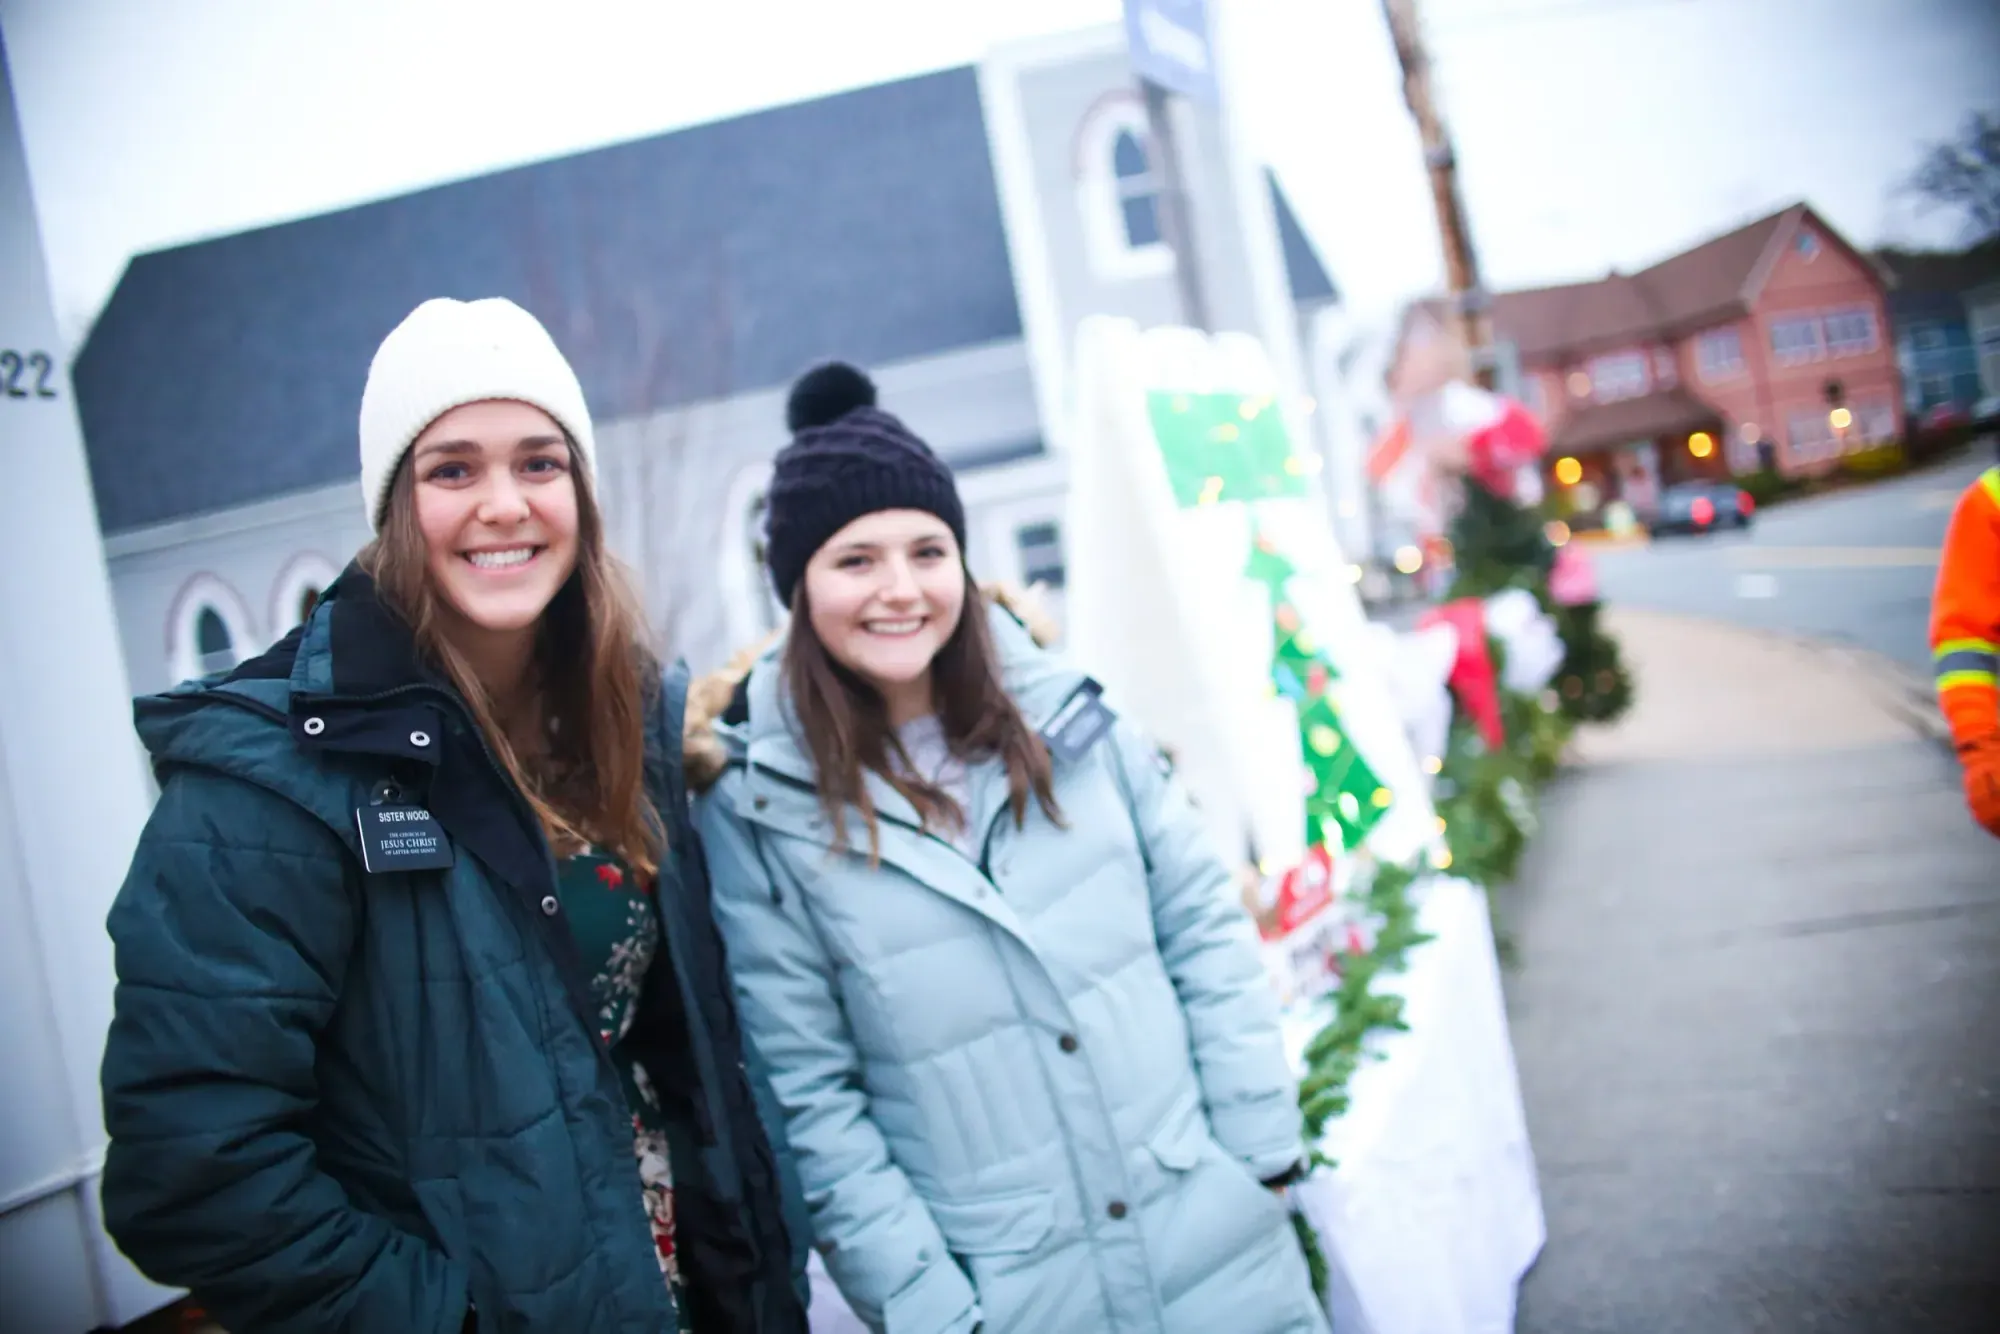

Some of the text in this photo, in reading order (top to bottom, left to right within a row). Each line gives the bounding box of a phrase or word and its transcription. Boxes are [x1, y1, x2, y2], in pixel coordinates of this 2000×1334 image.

[0, 350, 56, 398] 22
[379, 811, 429, 822] SISTER WOOD
[381, 838, 436, 850] JESUS CHRIST
